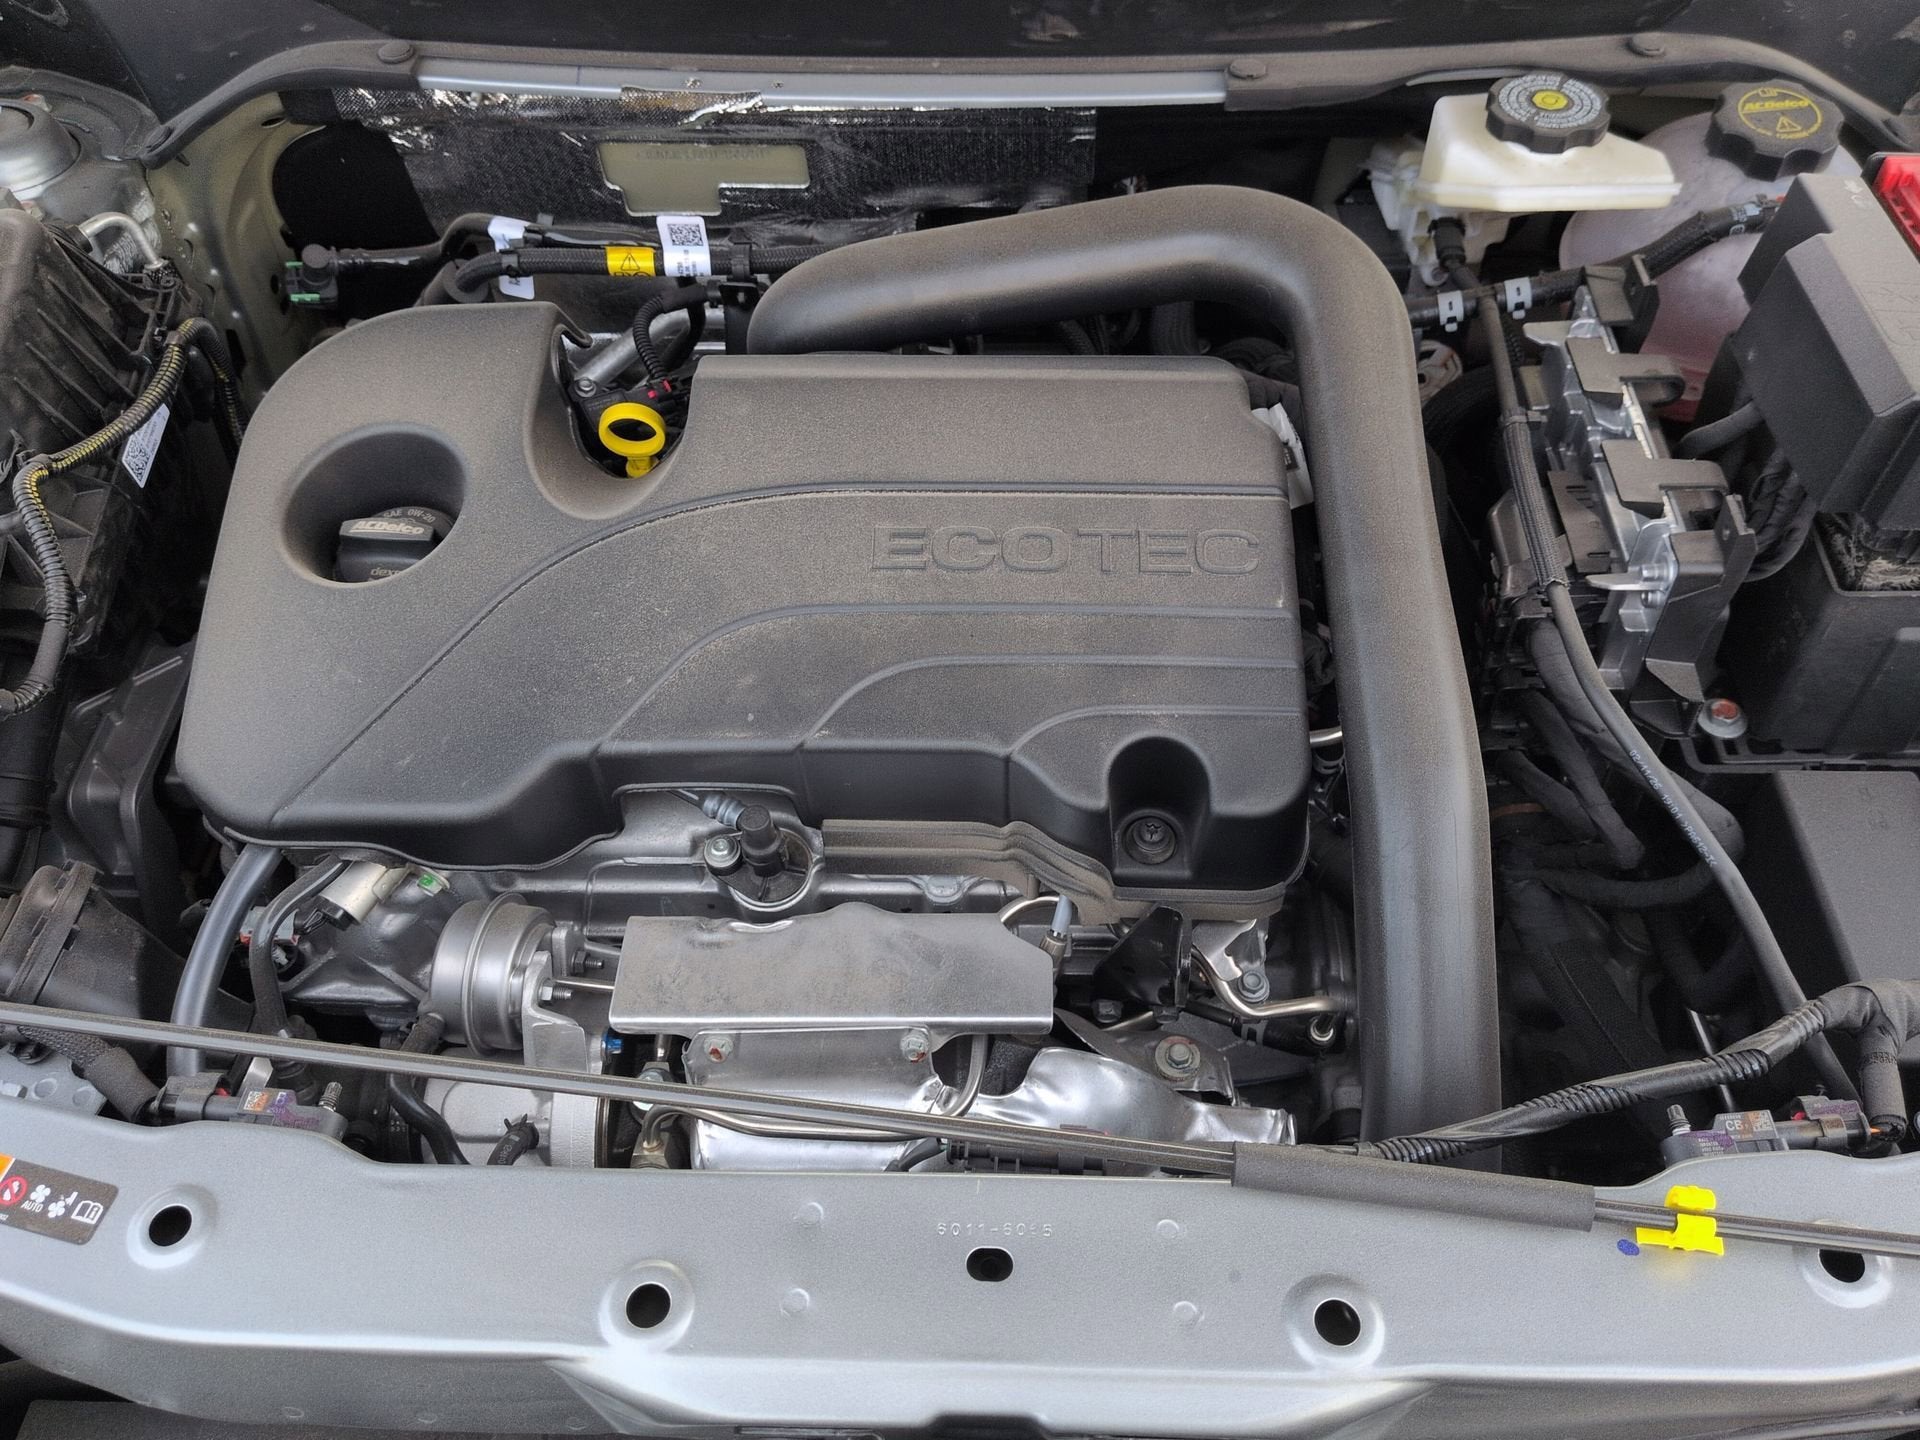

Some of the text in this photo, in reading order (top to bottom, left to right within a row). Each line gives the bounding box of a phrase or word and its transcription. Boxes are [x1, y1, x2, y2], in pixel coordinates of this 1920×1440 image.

[384, 509, 402, 518] SAE
[349, 521, 425, 535] ACDelco
[872, 525, 1260, 575] ECOTEC
[21, 1199, 44, 1213] AUTO
